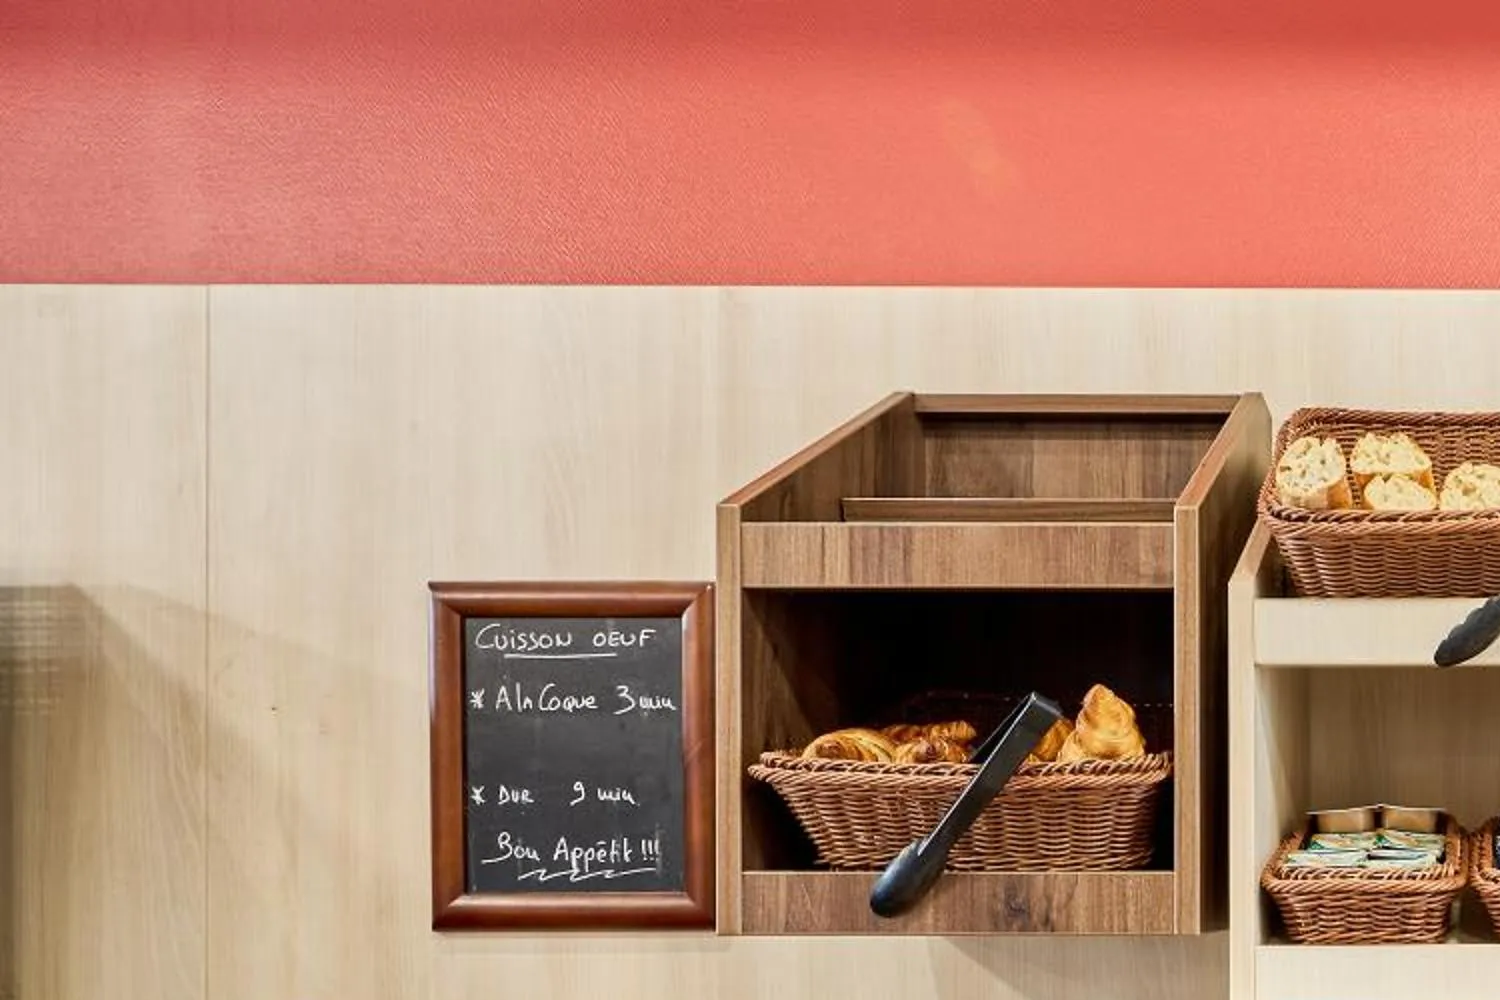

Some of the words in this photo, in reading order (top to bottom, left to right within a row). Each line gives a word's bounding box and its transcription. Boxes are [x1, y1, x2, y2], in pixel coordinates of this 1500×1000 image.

[612, 685, 636, 715] 3
[569, 781, 586, 806] 9
[480, 831, 541, 864] Bon
